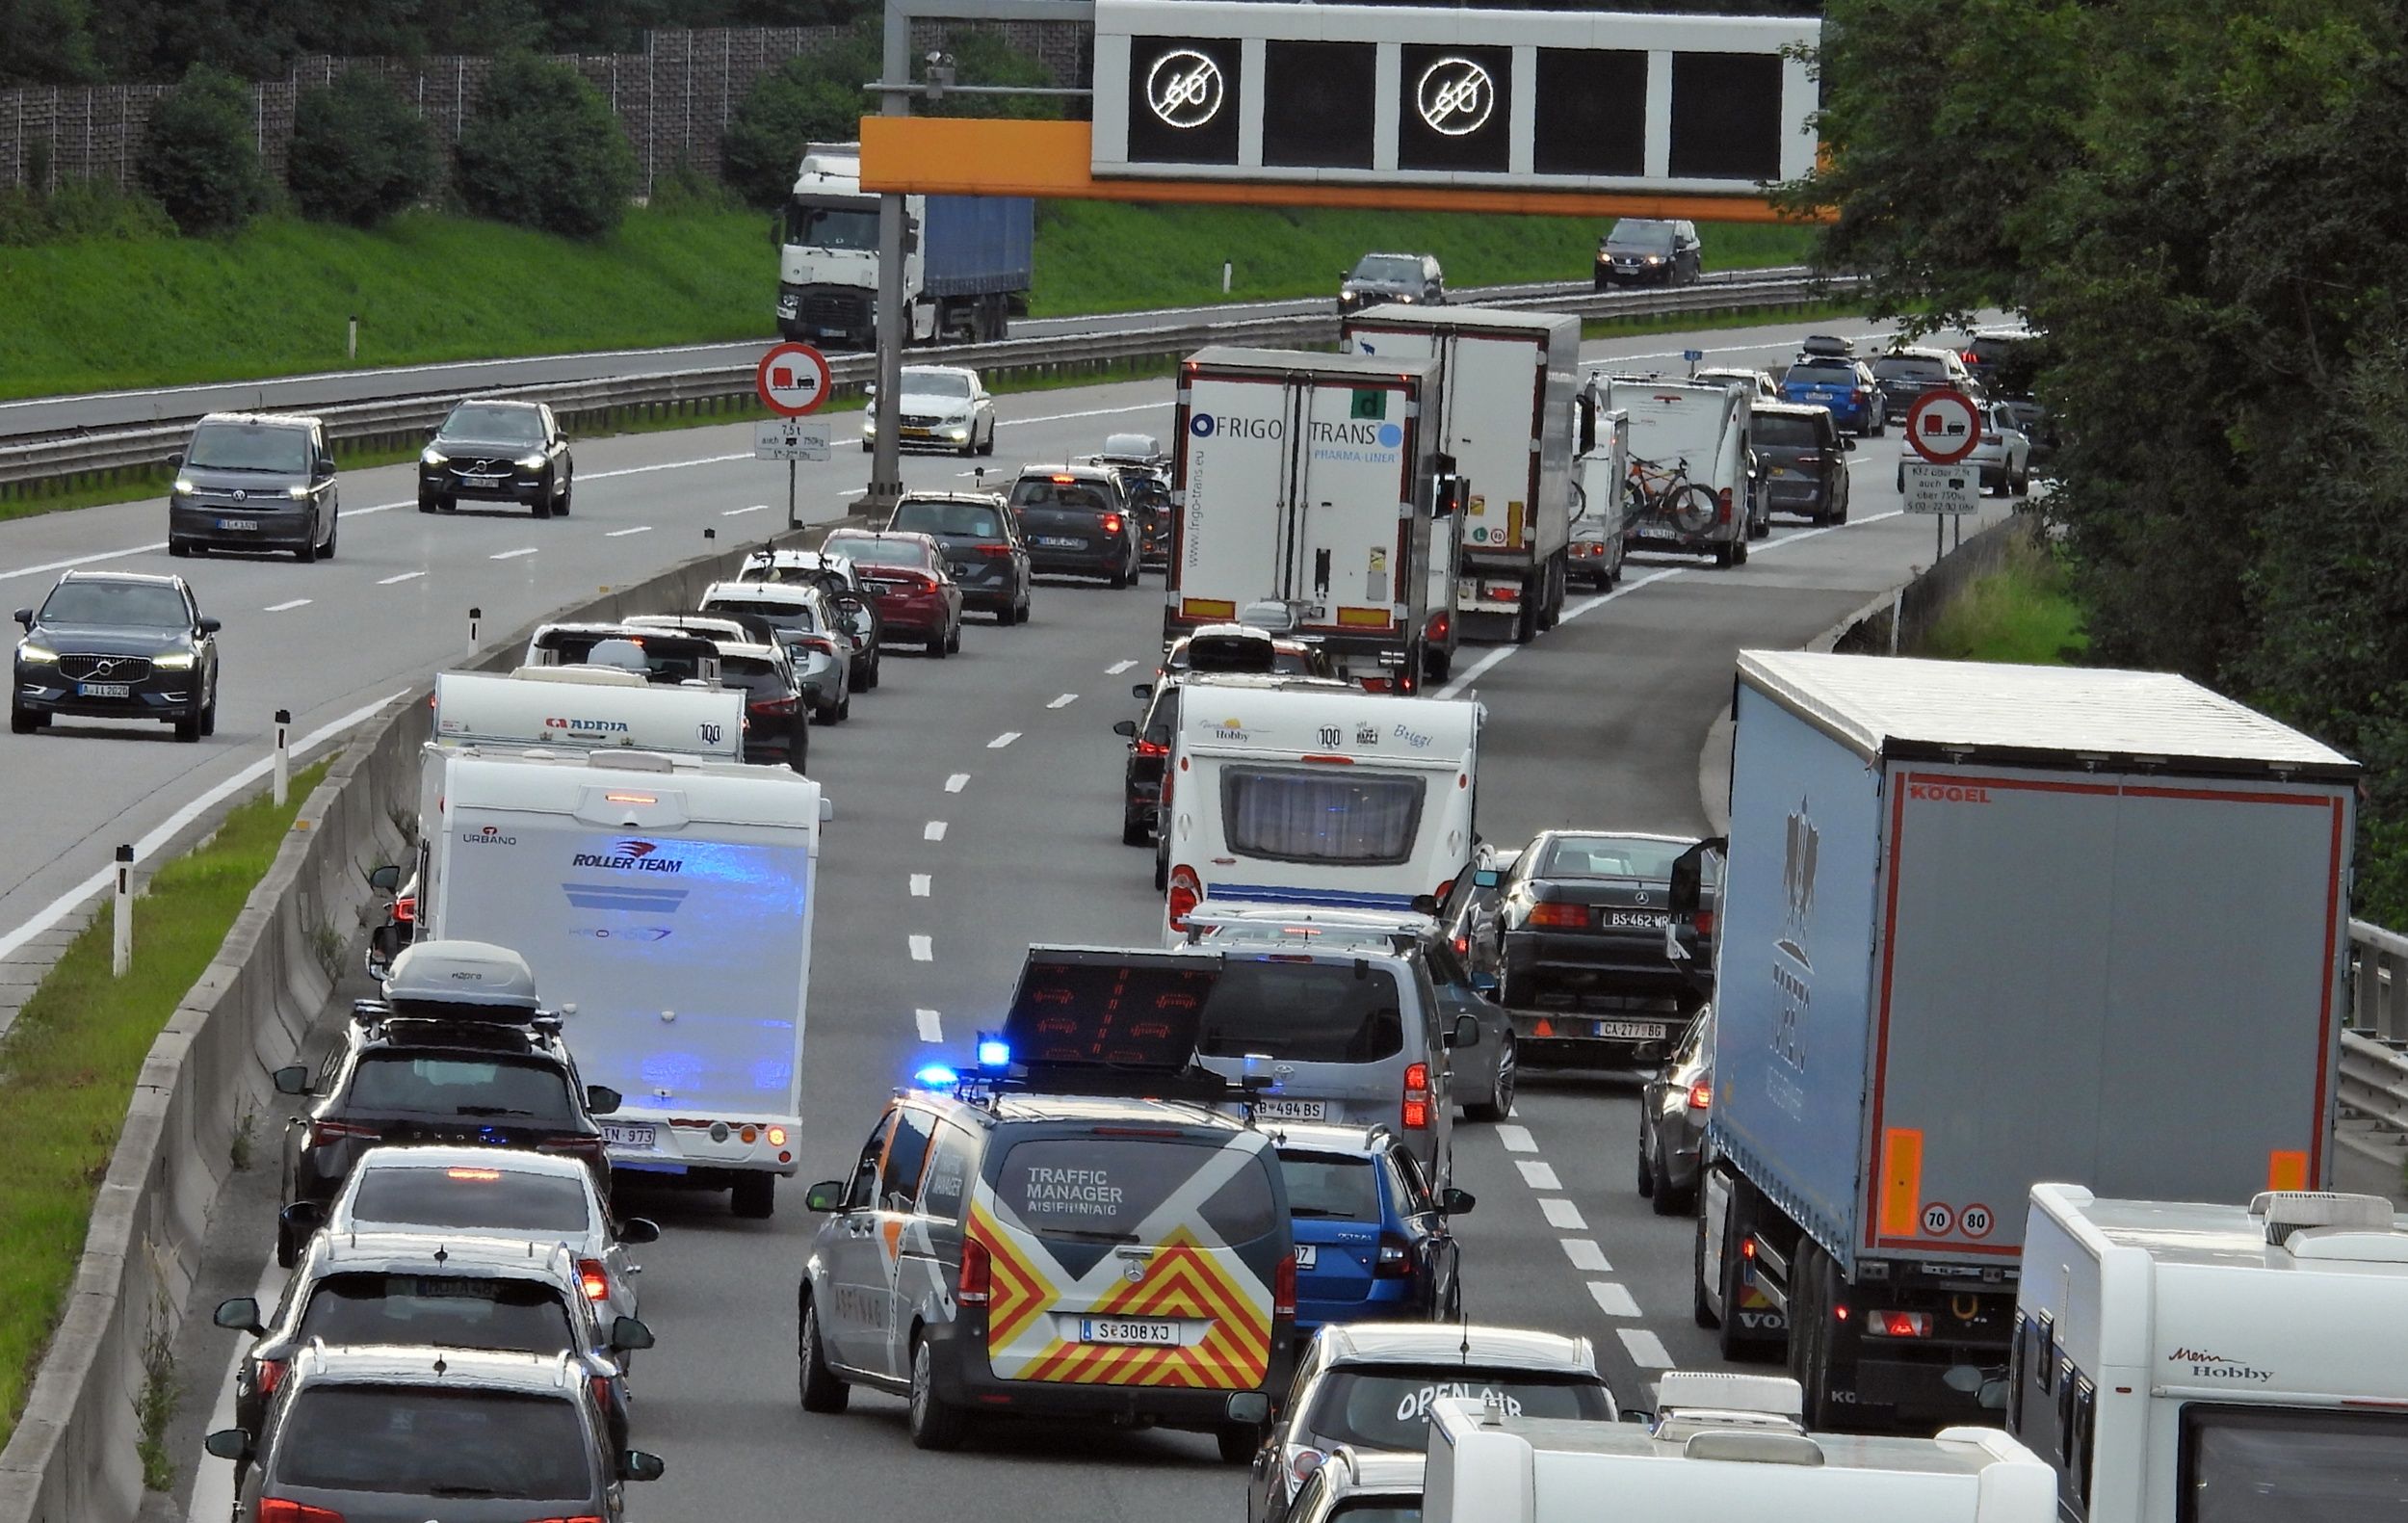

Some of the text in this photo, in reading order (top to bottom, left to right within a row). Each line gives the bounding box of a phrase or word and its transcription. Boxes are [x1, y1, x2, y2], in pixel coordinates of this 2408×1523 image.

[1165, 73, 1207, 105] 60
[1436, 80, 1478, 113] 60
[1217, 416, 1375, 444] FRIGO TRANS
[1314, 450, 1396, 463] PHARMA-LINER
[1189, 450, 1204, 567] www.frigo-trans.eu
[570, 720, 629, 732] ADRIA
[700, 723, 720, 741] 100
[1216, 729, 1250, 742] Hobby
[1320, 729, 1340, 746] 100
[462, 833, 517, 846] URBANO
[573, 853, 682, 873] ROLLER TEAM
[1276, 1103, 1300, 1116] 494
[1304, 1104, 1320, 1116] BS
[1029, 1168, 1107, 1185] TRAFFIC
[1027, 1184, 1123, 1202] MANAGER
[1929, 1213, 1945, 1226] 70
[1968, 1214, 1985, 1228] 80
[1099, 1324, 1109, 1337] S
[1120, 1325, 1147, 1339] 308
[1151, 1326, 1169, 1340] XJ
[2169, 1348, 2238, 1364] Mein
[2193, 1366, 2275, 1382] Hobby
